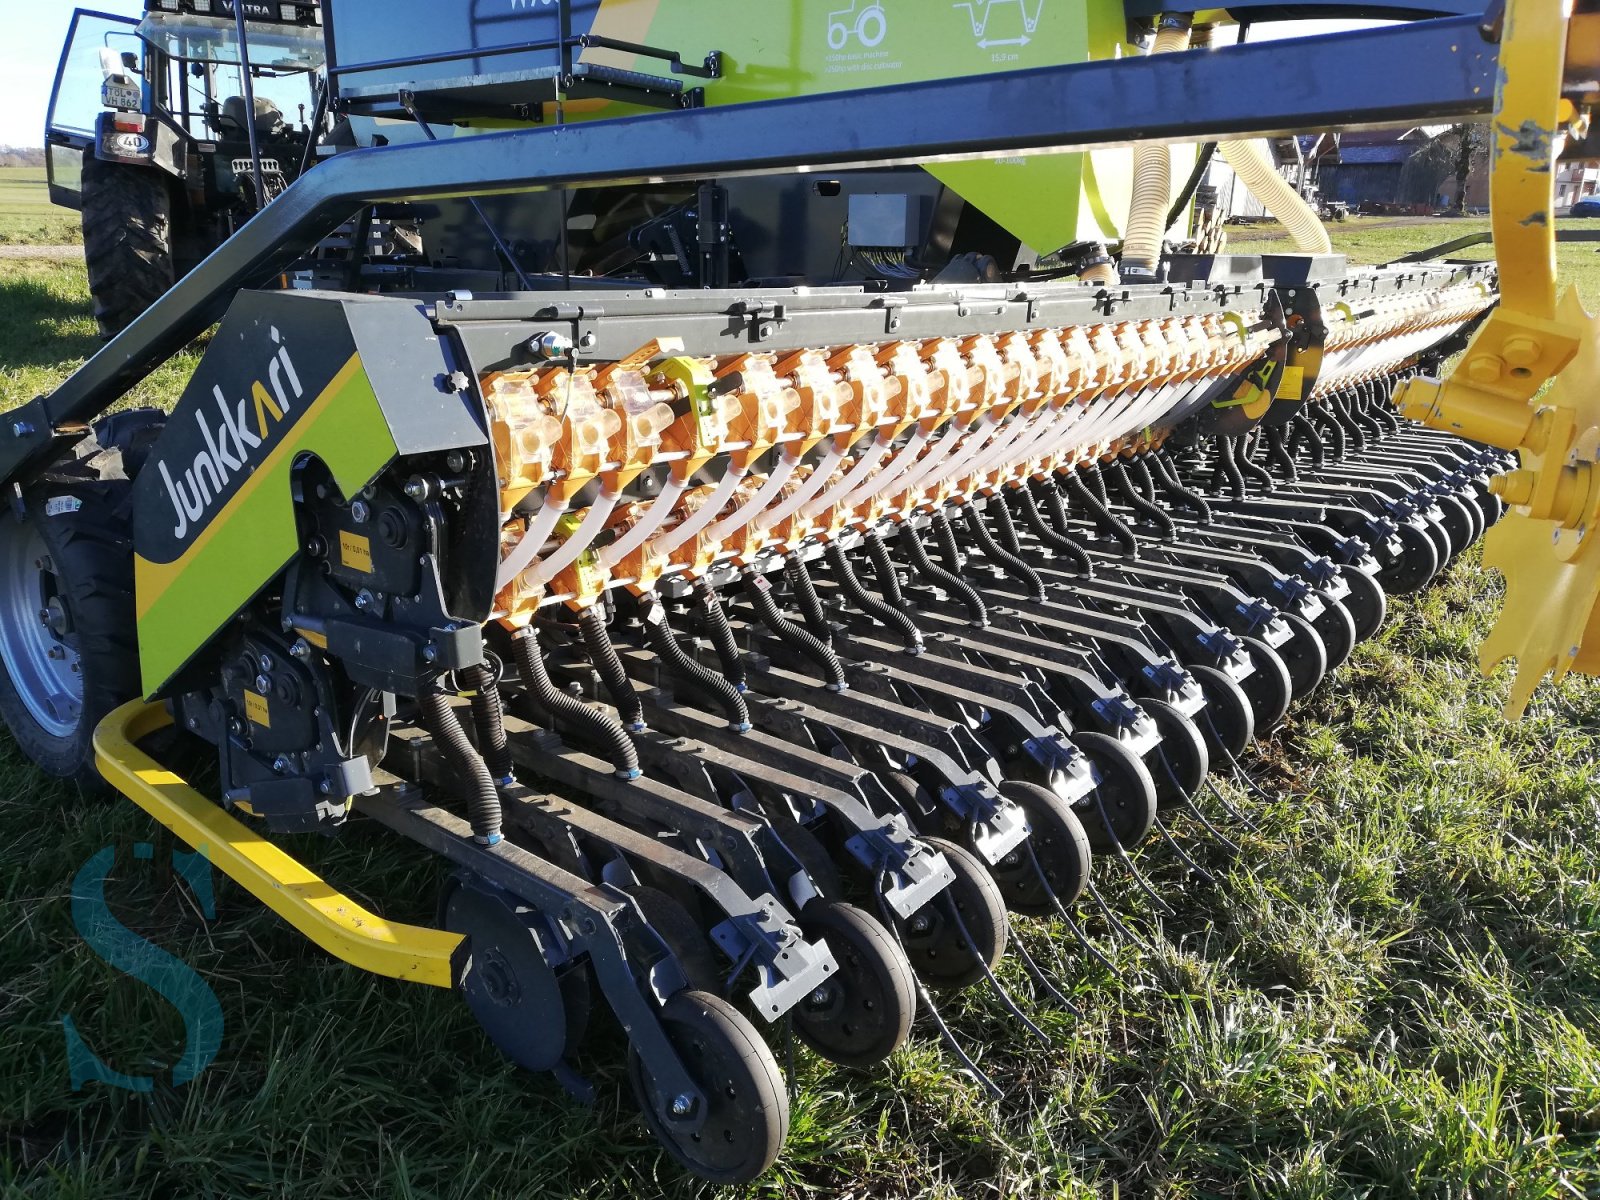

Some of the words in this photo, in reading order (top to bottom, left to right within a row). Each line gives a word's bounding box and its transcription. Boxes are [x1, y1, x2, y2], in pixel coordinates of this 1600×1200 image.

[222, 0, 270, 15] VLTRA
[120, 99, 138, 108] 862
[123, 136, 142, 147] 40
